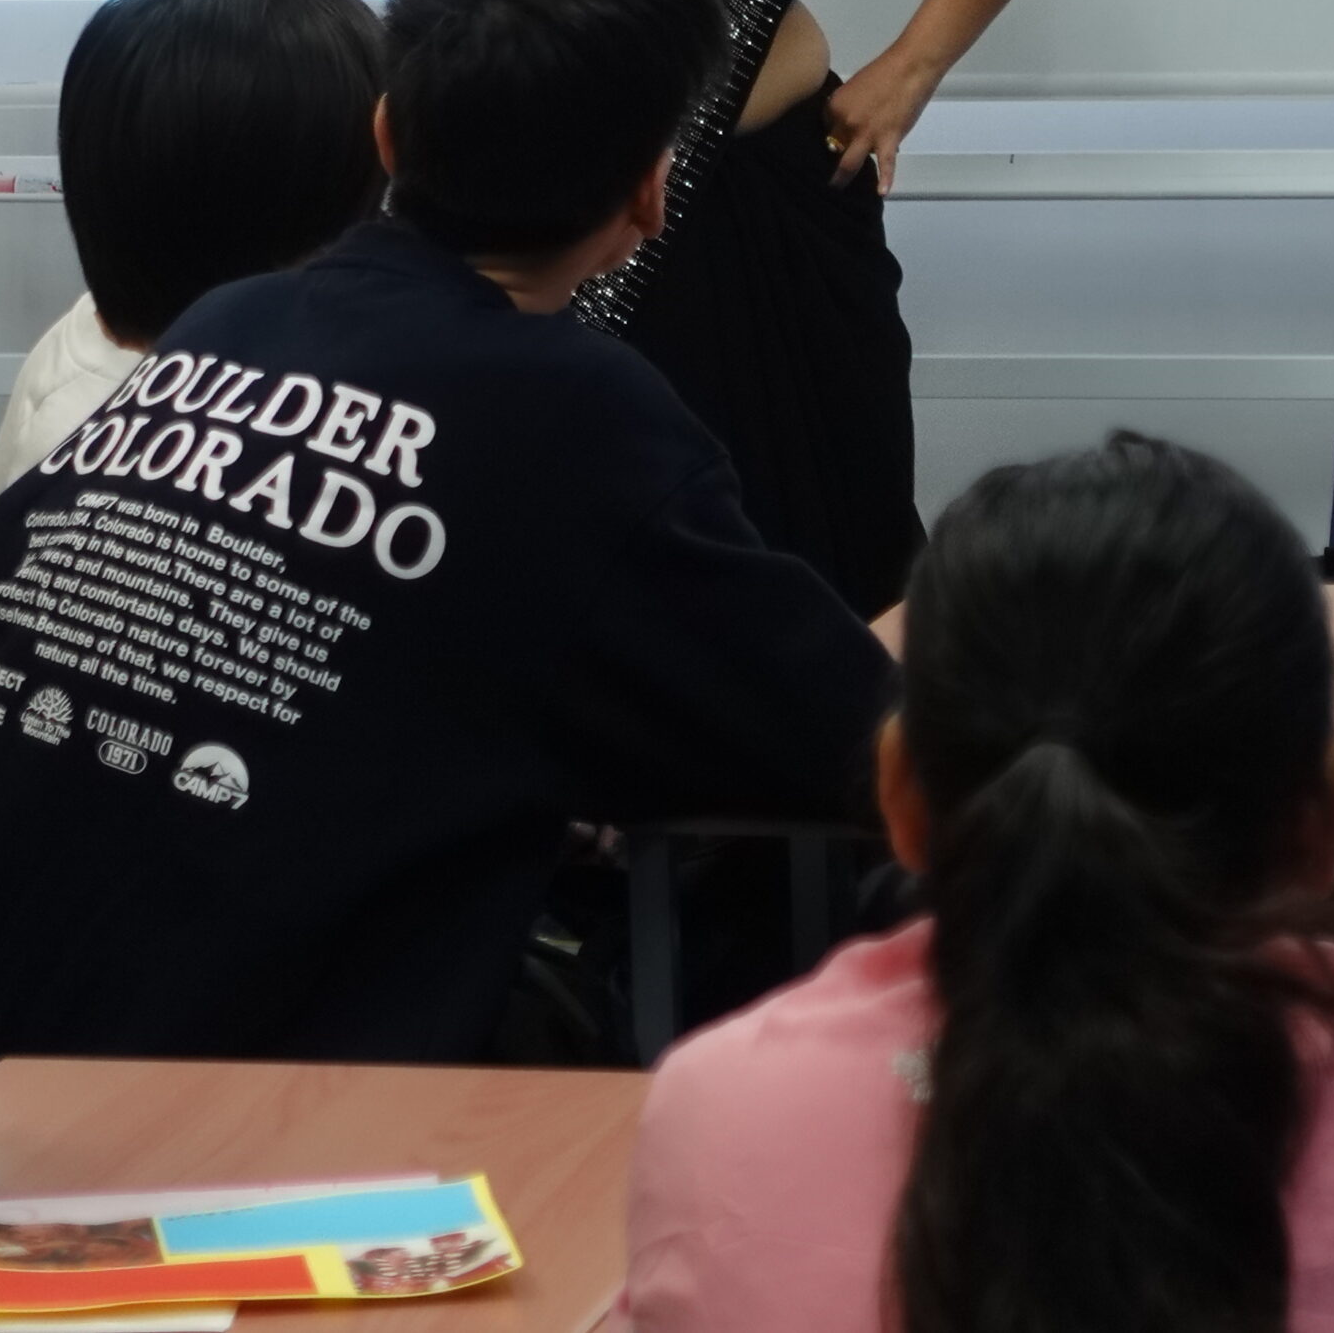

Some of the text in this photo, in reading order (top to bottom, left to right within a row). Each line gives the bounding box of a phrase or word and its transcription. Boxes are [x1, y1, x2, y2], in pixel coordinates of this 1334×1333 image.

[94, 515, 154, 544] Colorado
[155, 529, 172, 551] is
[173, 538, 227, 571] home
[230, 559, 252, 582] to
[255, 572, 311, 606] some
[314, 595, 339, 616] of
[340, 603, 372, 631] the
[117, 500, 143, 517] was
[145, 503, 180, 530] born
[181, 514, 200, 536] in
[206, 524, 287, 574] Boulder,
[53, 573, 82, 594] and
[79, 581, 175, 627] comfortable
[177, 616, 229, 649] days.
[237, 636, 270, 664] We
[273, 653, 343, 693] should
[75, 556, 104, 577] and
[102, 565, 194, 610] mountains.
[208, 599, 257, 635] They
[258, 624, 301, 652] give
[304, 641, 329, 663] us
[87, 534, 101, 553] in
[102, 539, 124, 560] the
[229, 587, 264, 612] are
[267, 603, 283, 620] a
[286, 606, 316, 633] lot
[319, 623, 344, 643] of
[34, 641, 178, 705] nature all the time.
[36, 590, 58, 611] the
[57, 596, 124, 635] Colorado
[126, 623, 190, 658] nature
[193, 645, 269, 688] forever
[270, 675, 298, 702] by
[96, 637, 117, 656] of
[118, 642, 157, 674] that,
[162, 660, 191, 684] we
[193, 670, 270, 715] respect
[272, 701, 303, 726] for
[86, 709, 174, 756] COLORADO
[105, 744, 139, 770] 1971
[173, 771, 250, 810] CAMP7
